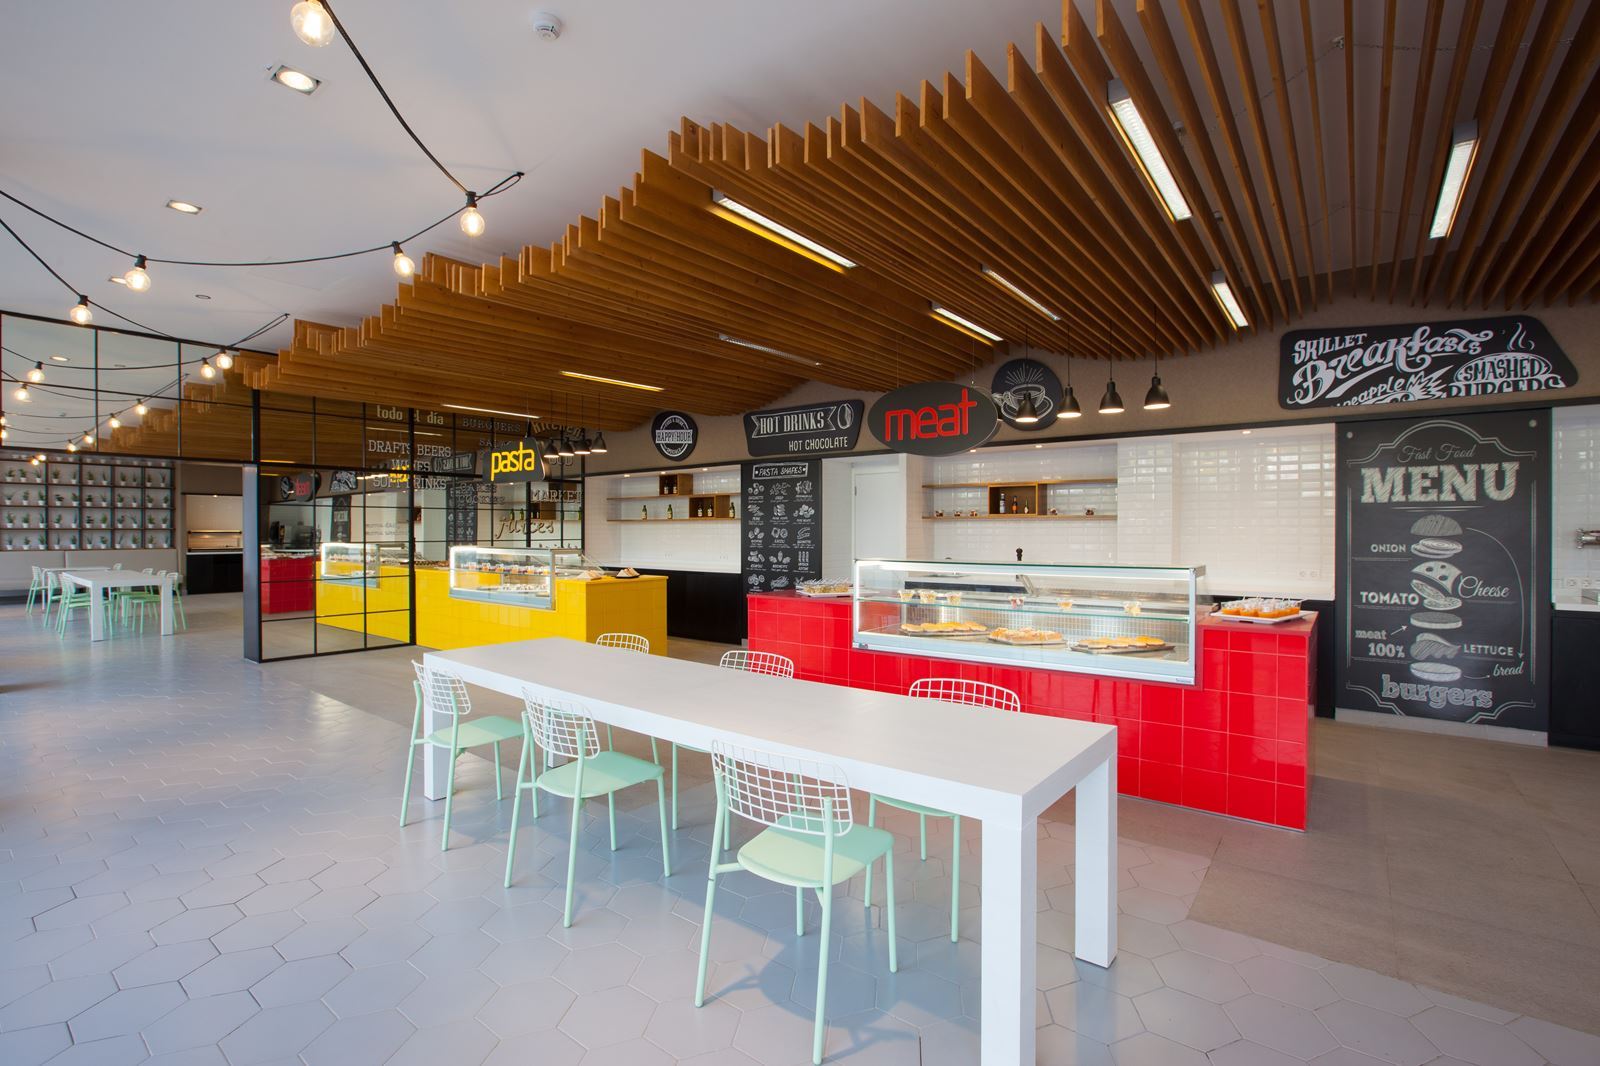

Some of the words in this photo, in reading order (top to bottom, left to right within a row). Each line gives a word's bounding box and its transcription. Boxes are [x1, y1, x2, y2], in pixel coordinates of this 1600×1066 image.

[1292, 333, 1367, 365] SKILLET
[1463, 358, 1543, 381] SMASHED
[377, 404, 403, 420] todo
[885, 387, 977, 442] meat
[760, 417, 780, 434] HOT
[784, 411, 824, 432] DRINKS
[417, 444, 451, 458] BEERS
[789, 440, 803, 452] HOT
[805, 437, 848, 451] CHOCOLATE
[1397, 445, 1432, 463] Fast
[1434, 443, 1477, 462] Food
[490, 441, 535, 481] pasta
[1360, 461, 1520, 503] MENU
[1371, 543, 1406, 553] ONION
[1458, 575, 1510, 599] Cheese
[1360, 591, 1420, 606] TOMATO
[1355, 629, 1387, 640] meat
[1368, 642, 1406, 658] 100%
[1463, 643, 1514, 657] LETTUCE
[1493, 662, 1524, 677] bread
[1381, 673, 1493, 709] burgers
